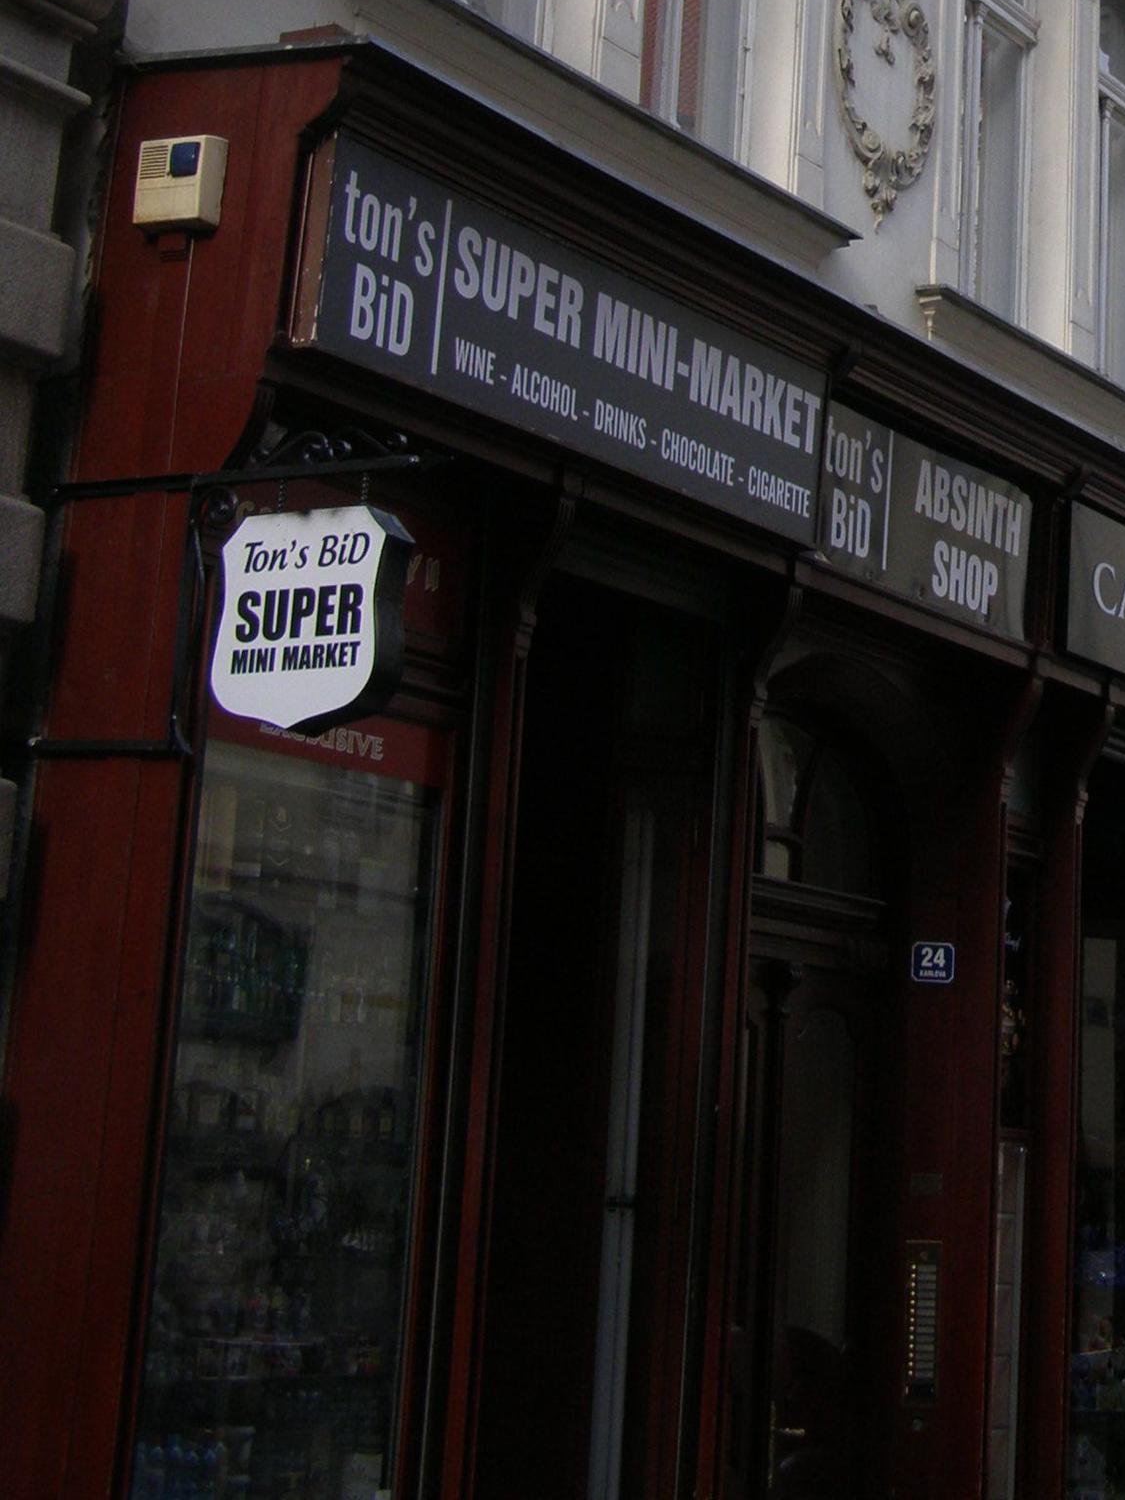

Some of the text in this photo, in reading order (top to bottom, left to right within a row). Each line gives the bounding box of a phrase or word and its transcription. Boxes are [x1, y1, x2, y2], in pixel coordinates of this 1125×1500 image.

[344, 170, 436, 277] ton's
[350, 263, 414, 356] BiD
[454, 226, 821, 454] SUPER MINI-MARKET
[455, 337, 497, 385] WINE
[511, 363, 578, 421] ALCOHOL
[594, 398, 647, 450] DRINKS
[661, 428, 736, 487] CHOCOLATE
[748, 465, 811, 519] CIGARETTE
[825, 415, 884, 494] ton's
[831, 488, 871, 558] BiD
[914, 459, 1023, 556] ABSINTH
[244, 532, 370, 574] Ton's BiD
[932, 539, 999, 615] SHOP
[235, 583, 364, 643] SUPER
[230, 641, 361, 675] MINI MARKET
[919, 969, 947, 978] KARLOVA
[921, 947, 946, 968] 24
